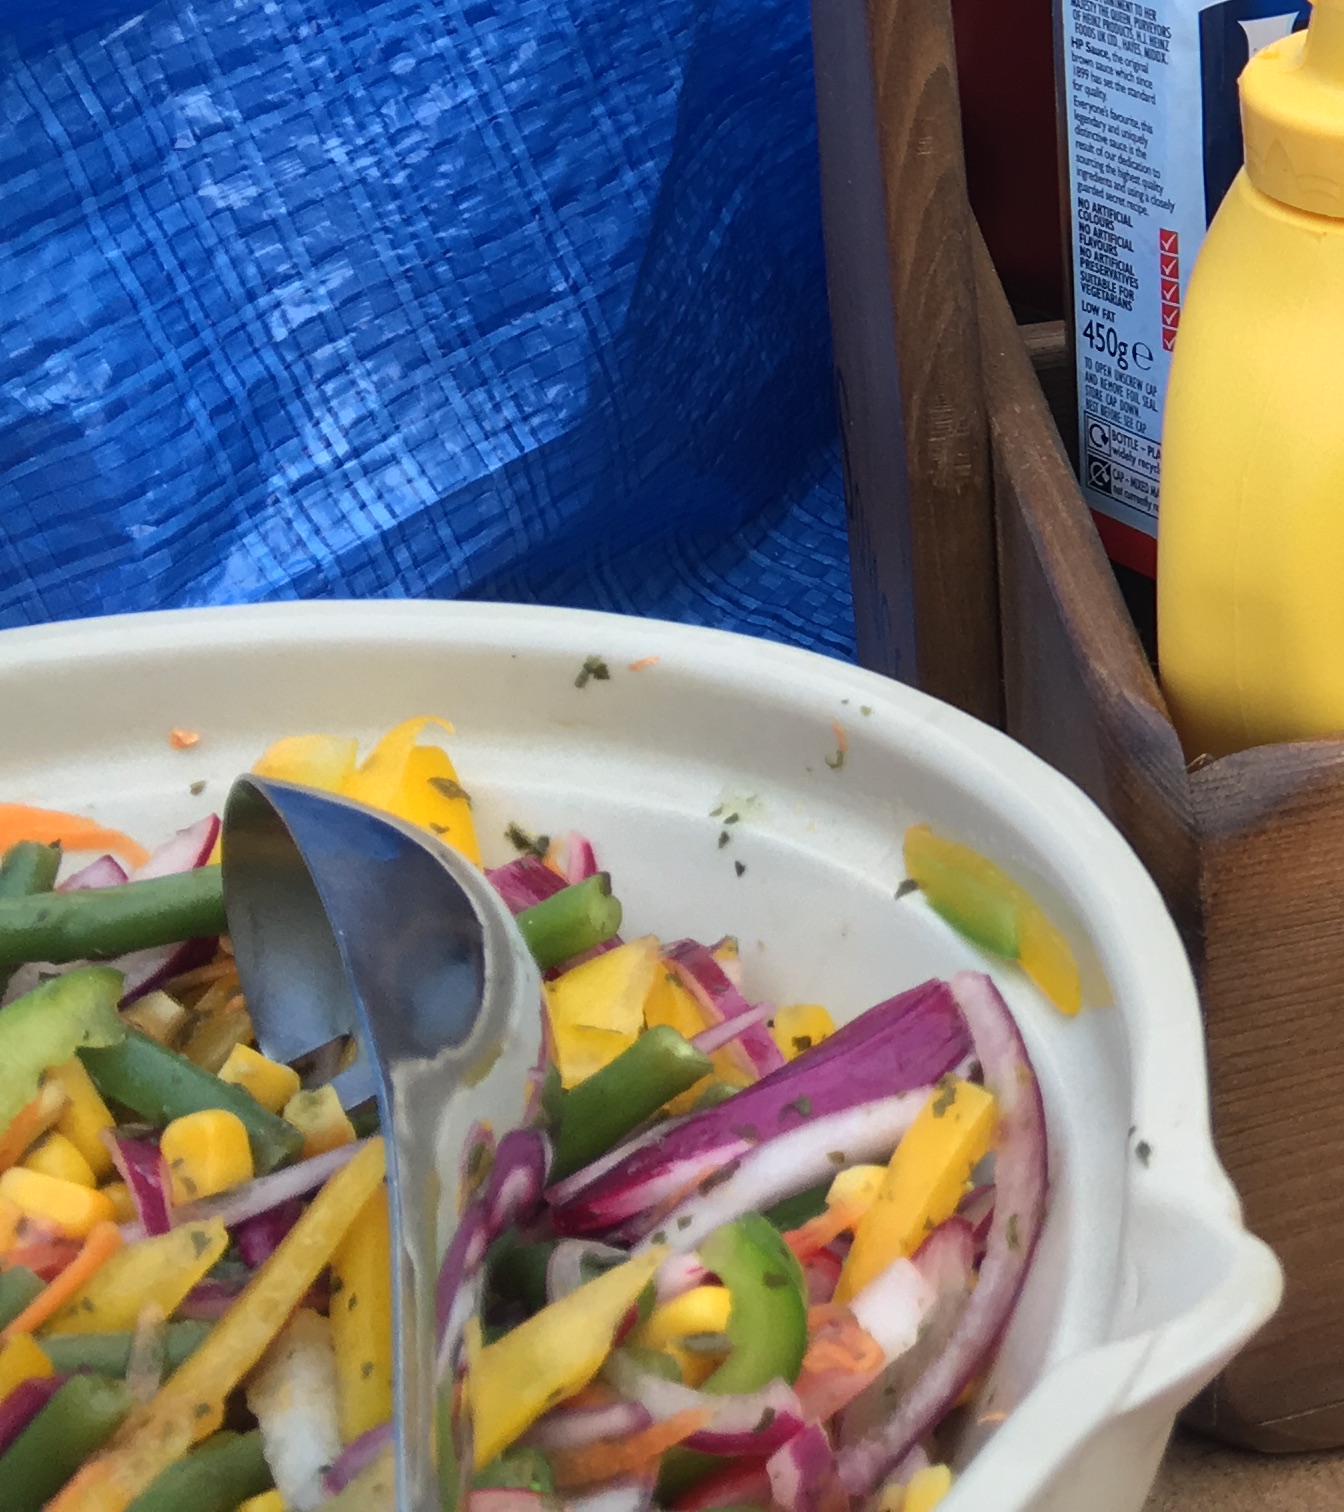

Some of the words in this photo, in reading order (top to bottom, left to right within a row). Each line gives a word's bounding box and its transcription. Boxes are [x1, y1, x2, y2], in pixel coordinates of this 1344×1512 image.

[1077, 208, 1115, 231] COLOURS
[1092, 201, 1134, 228] ARTIFICIAL
[1079, 232, 1119, 257] FLAVOURS
[1093, 226, 1135, 253] ARTIFICIAL
[1080, 257, 1139, 290] PRESERVATIVES
[1094, 250, 1136, 276] ARTIFICIAL
[1080, 270, 1117, 294] SUITABLE
[1118, 285, 1135, 302] FOR
[1080, 281, 1133, 312] VEGETARIANS
[1081, 300, 1100, 317] LOW
[1102, 308, 1116, 323] FAT
[1082, 319, 1128, 371] 450g
